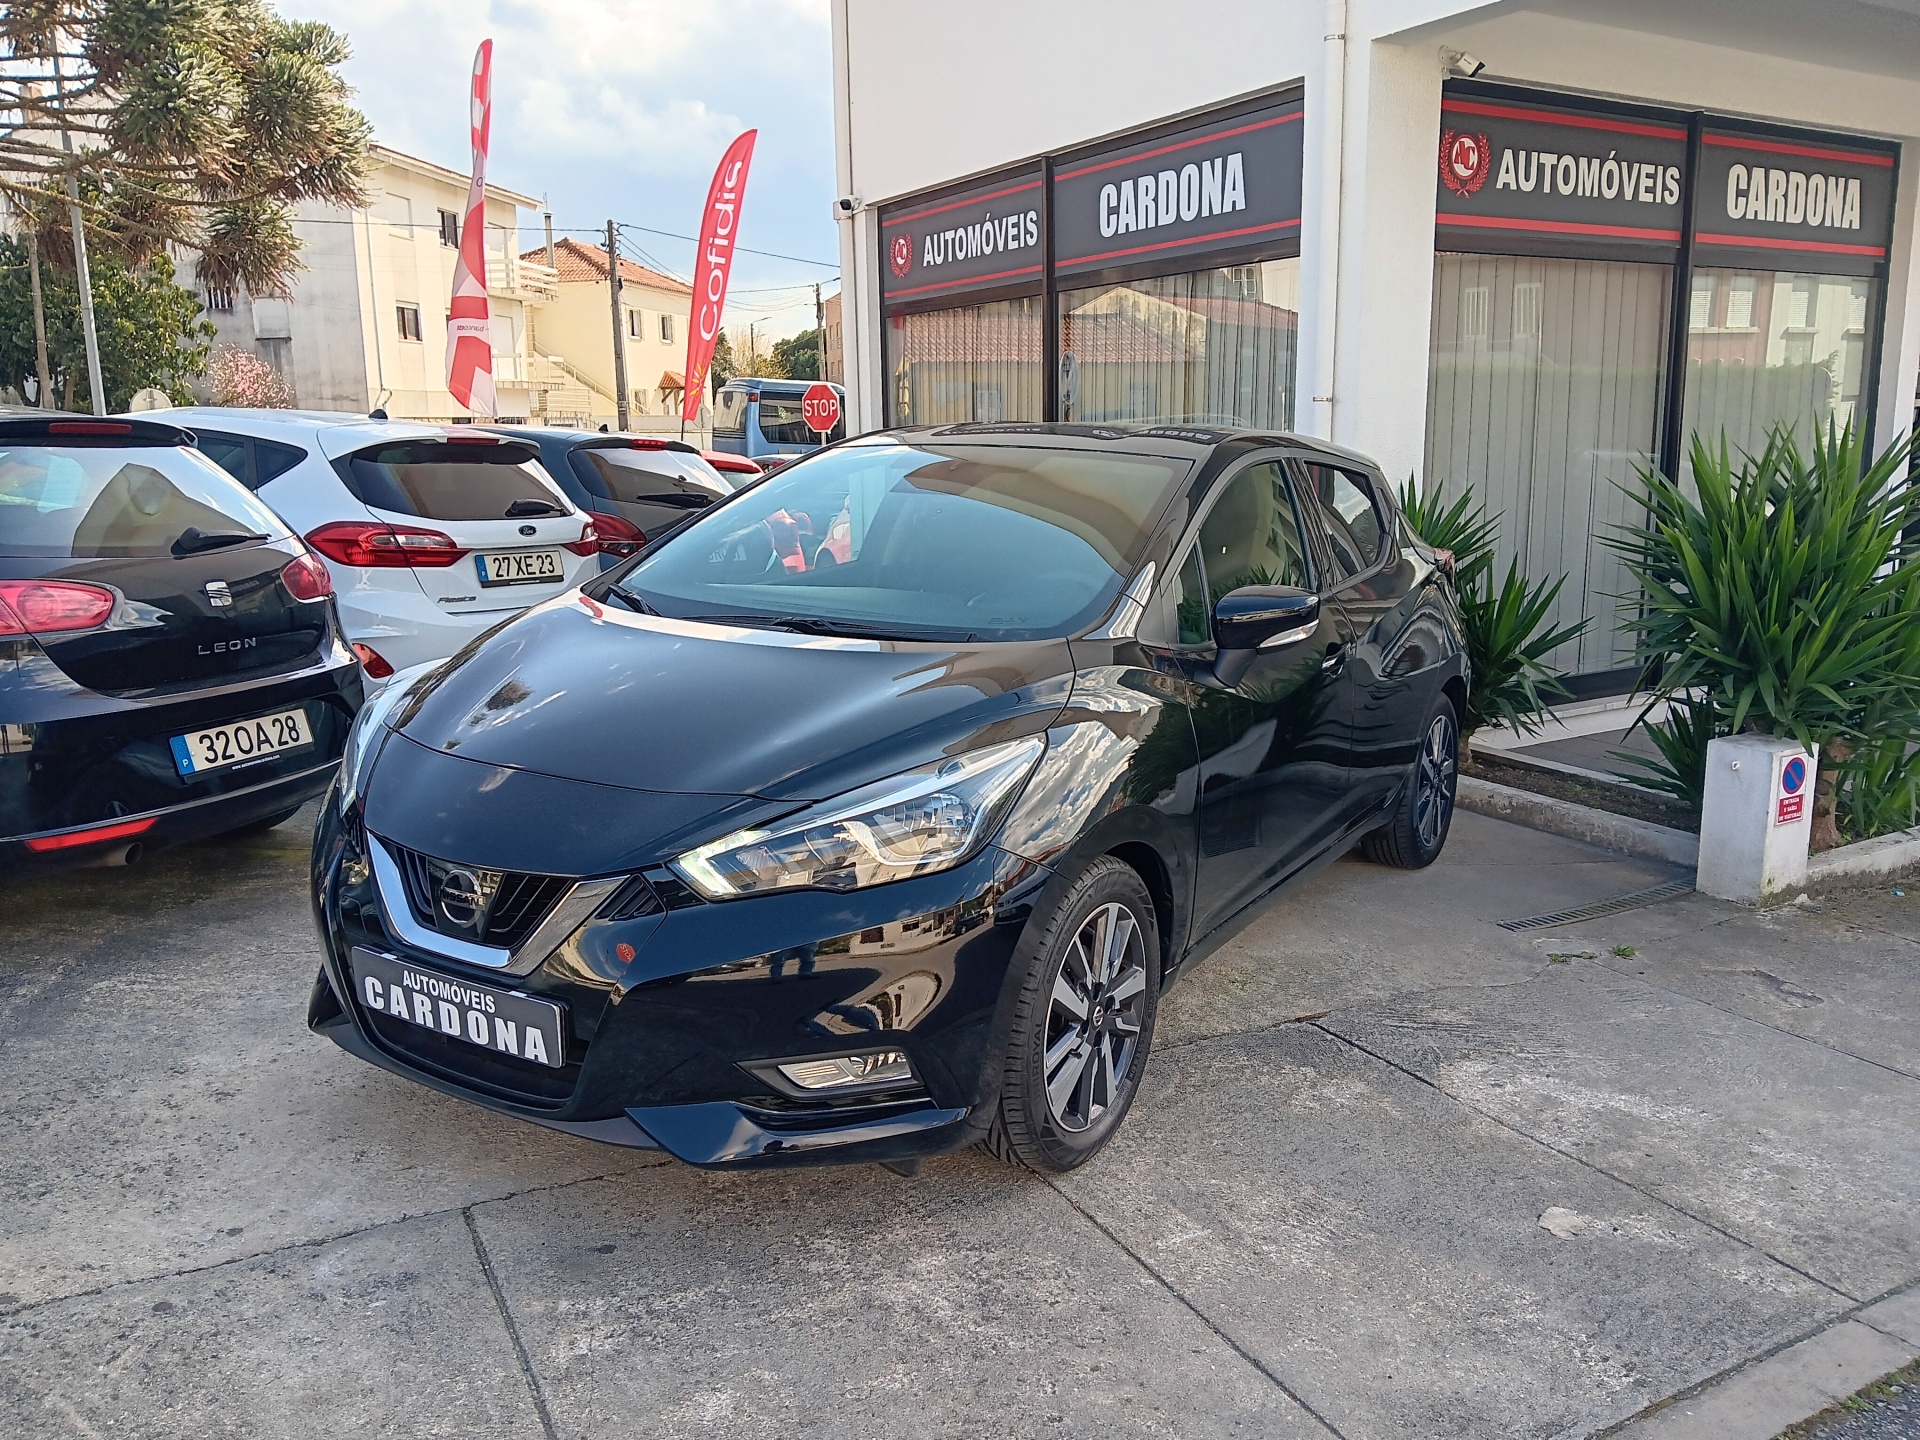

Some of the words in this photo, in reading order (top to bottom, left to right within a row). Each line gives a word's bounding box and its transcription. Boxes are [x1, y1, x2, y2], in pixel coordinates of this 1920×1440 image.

[1100, 152, 1246, 238] CARDONA
[1496, 148, 1680, 205] AUTOMÓVEIS
[1726, 163, 1861, 230] CARDONA
[700, 160, 743, 341] Cofidis
[922, 210, 1039, 267] AUTOMÓVEIS
[804, 399, 837, 417] STOP
[198, 637, 257, 655] LEON
[182, 758, 189, 767] P
[364, 976, 549, 1065] CARDONA
[402, 970, 496, 1014] AUTOMÓVEIS
